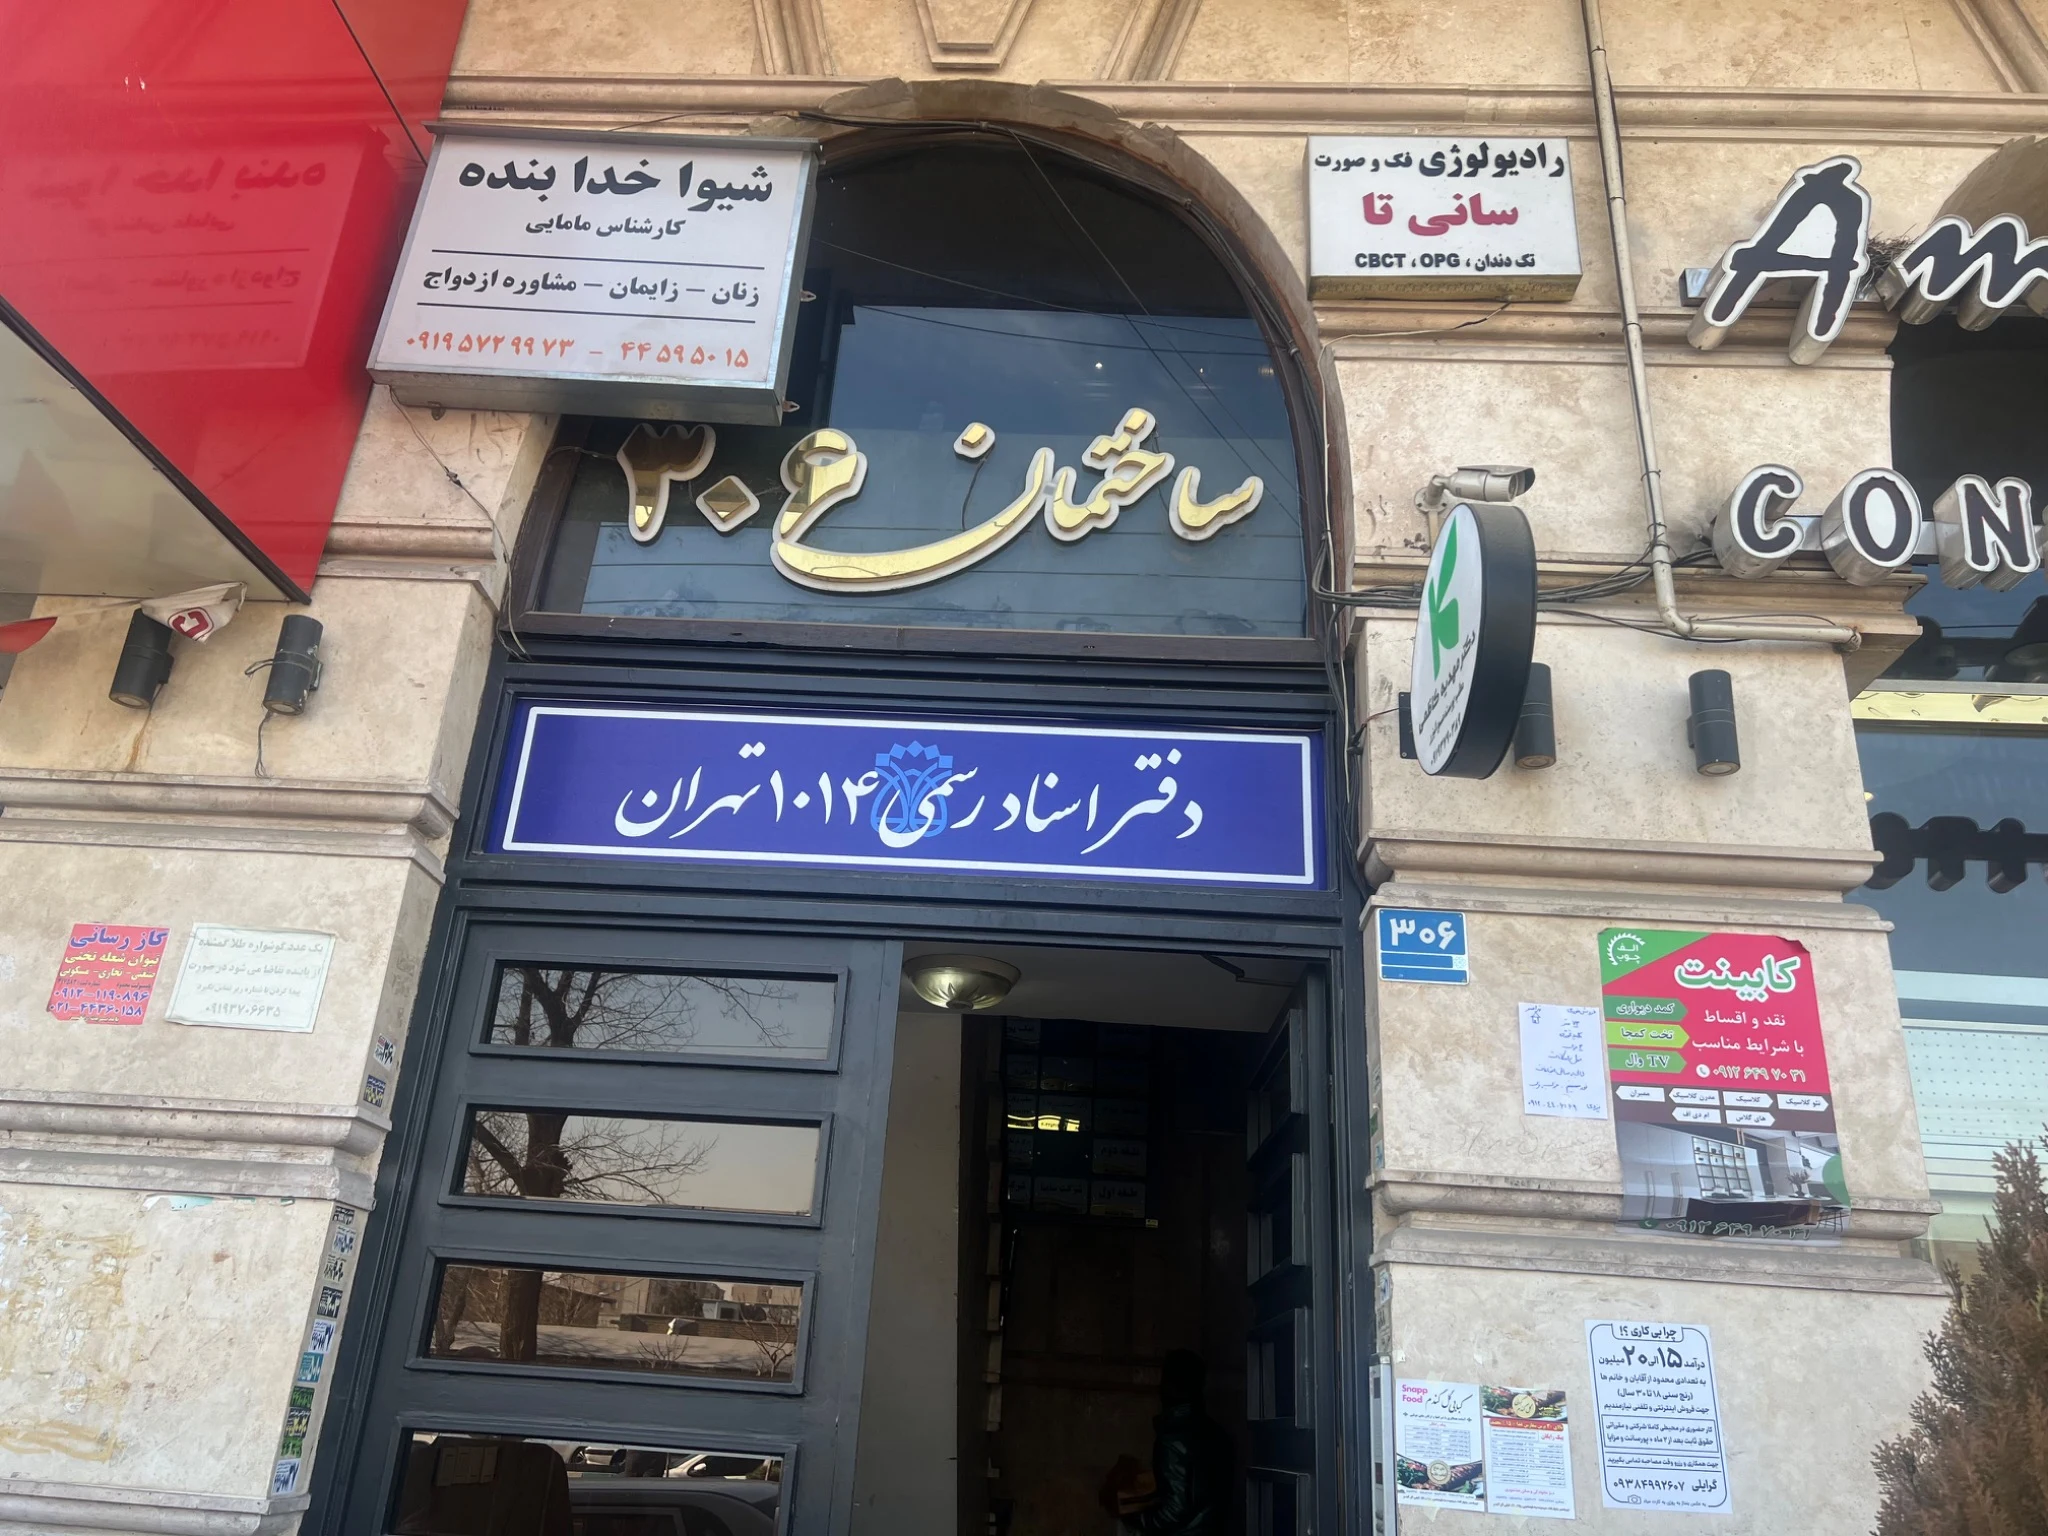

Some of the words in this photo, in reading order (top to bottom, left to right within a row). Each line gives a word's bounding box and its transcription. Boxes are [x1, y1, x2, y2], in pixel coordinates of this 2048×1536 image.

[1315, 153, 1365, 172] صورت
[1371, 156, 1379, 172] و
[1384, 152, 1412, 167] فک
[1419, 142, 1564, 178] رادیولوژی
[459, 158, 556, 202] بنده
[574, 155, 661, 195] خدا
[678, 164, 772, 212] شیوا
[1362, 191, 1393, 225] تا
[1408, 192, 1519, 237] سانی
[525, 213, 591, 234] مامایی
[595, 217, 686, 240] کارشناس
[1355, 253, 1406, 268] CBCT
[1515, 254, 1535, 268] تک
[502, 269, 578, 296] مشاوره
[609, 277, 679, 302] زایمان
[710, 280, 760, 307] زنان
[615, 421, 869, 547] ۳۰۶
[770, 406, 1264, 592] ساختمان
[614, 740, 767, 840] تهران
[770, 767, 882, 826] ۱۰۱۴
[877, 763, 987, 849] رسمی
[992, 770, 1102, 836] اسناد
[1079, 746, 1205, 855] دفتر
[70, 927, 130, 950] رسانی
[133, 930, 168, 950] گاز
[1389, 917, 1457, 950] ۳۰۶
[1617, 943, 1639, 952] الف
[100, 951, 126, 963] شعله
[1616, 953, 1640, 964] چوب
[1674, 954, 1800, 1003] کابینت
[1616, 1001, 1651, 1017] دیواری
[1653, 1001, 1675, 1014] کمد
[1703, 1010, 1746, 1025] اقساط
[1751, 1019, 1758, 1029] و
[1763, 1014, 1785, 1027] نقد
[1650, 1029, 1673, 1040] تخت
[1692, 1036, 1741, 1053] مناسب
[1745, 1038, 1791, 1057] شرایط
[1793, 1040, 1804, 1057] با
[1625, 1053, 1644, 1067] وال
[1647, 1055, 1670, 1067] TV
[1631, 1326, 1649, 1337] کاری
[1651, 1330, 1662, 1339] بی
[1663, 1327, 1677, 1342] چرا
[1599, 1355, 1625, 1366] میلیون
[1622, 1345, 1648, 1366] ۲۰
[1648, 1356, 1659, 1366] الی
[1657, 1347, 1683, 1368] ۱۵
[1684, 1358, 1705, 1370] درآمد
[1653, 1377, 1674, 1385] محدود
[1675, 1376, 1698, 1385] تعدادی
[1402, 1384, 1429, 1396] Snapp
[1663, 1392, 1678, 1400] سنی
[1402, 1394, 1423, 1404] Food
